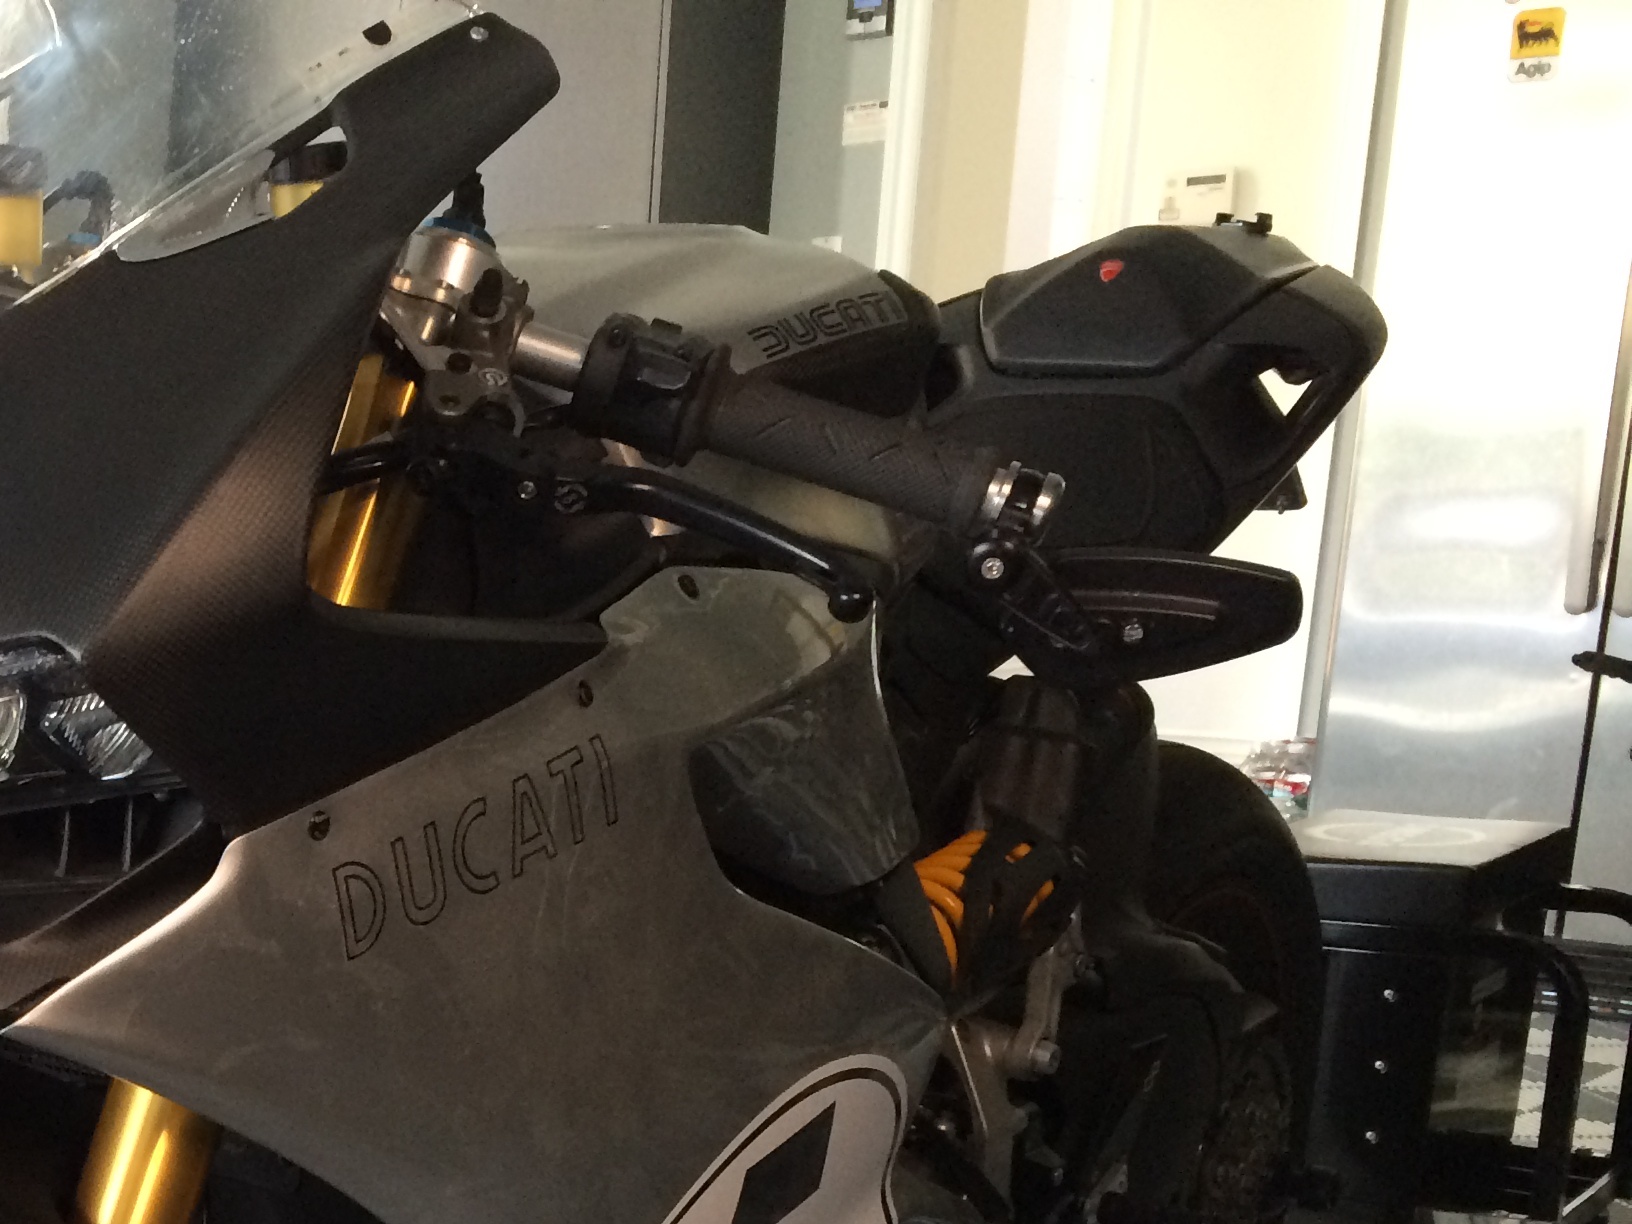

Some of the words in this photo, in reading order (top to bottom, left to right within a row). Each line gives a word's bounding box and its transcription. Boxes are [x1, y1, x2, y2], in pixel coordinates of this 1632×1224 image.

[1515, 61, 1552, 78] Agip
[747, 291, 905, 359] DUCATI
[331, 734, 618, 961] DUCATI
